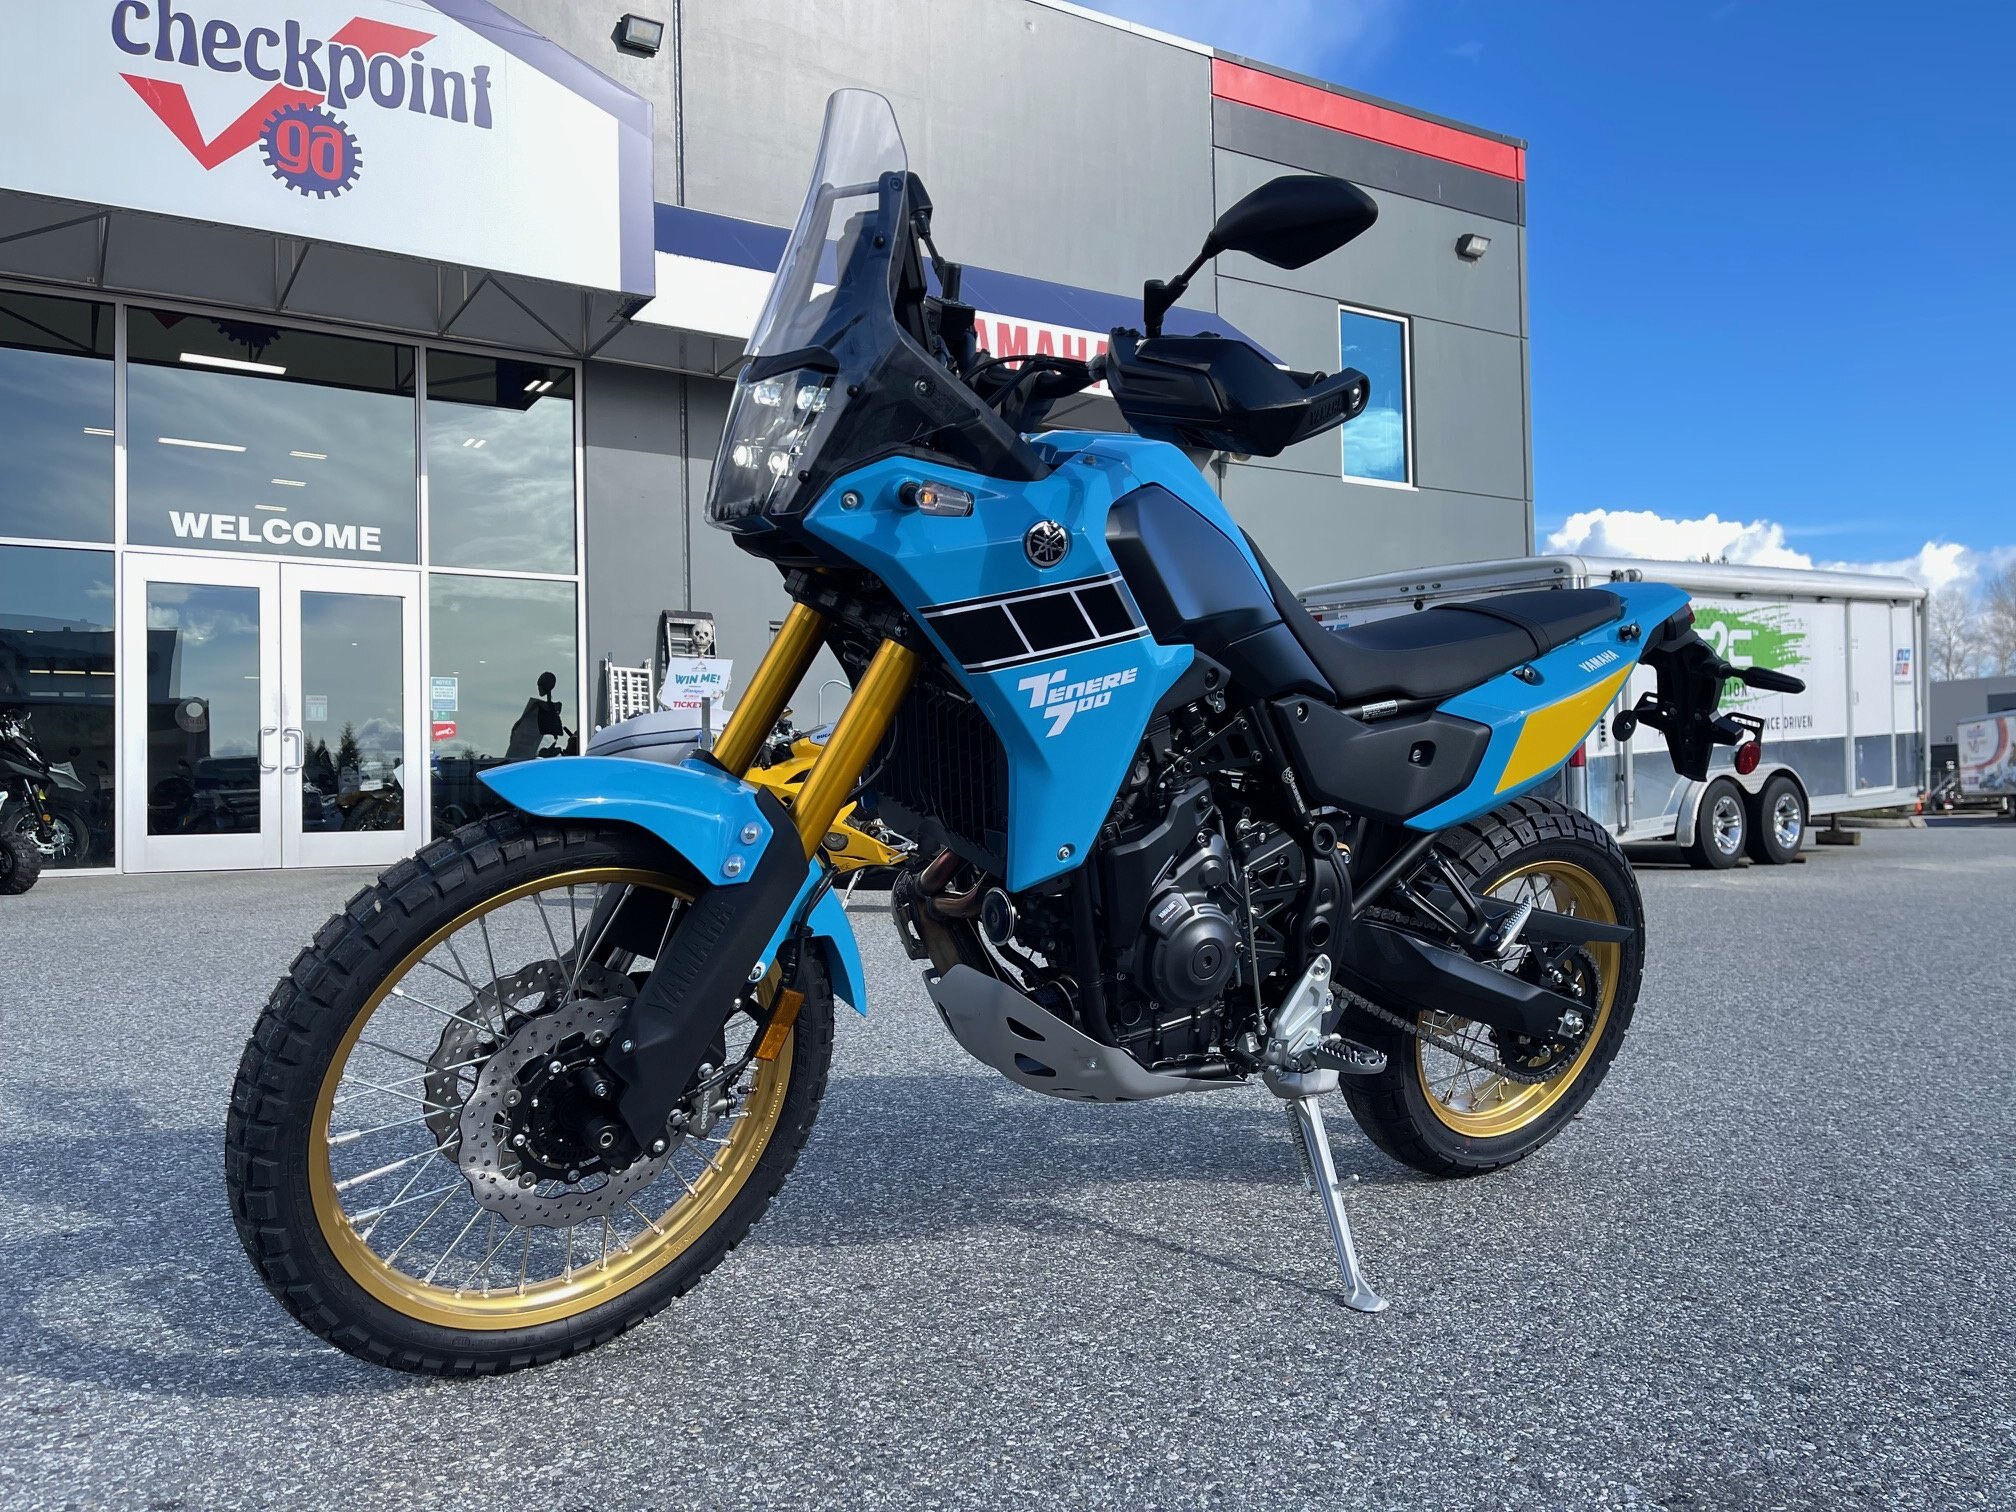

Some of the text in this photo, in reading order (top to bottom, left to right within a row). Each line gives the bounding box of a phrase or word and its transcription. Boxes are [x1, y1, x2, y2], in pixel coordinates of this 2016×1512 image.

[111, 0, 493, 130] checkpoint
[974, 318, 1109, 388] AMAH
[168, 510, 382, 552] WELCOME
[675, 673, 721, 685] WIN ME!
[1578, 649, 1620, 673] YAMAHA
[1043, 690, 1113, 738] 700
[1783, 714, 1813, 729] DRIVEN
[700, 1090, 712, 1130] brembo
